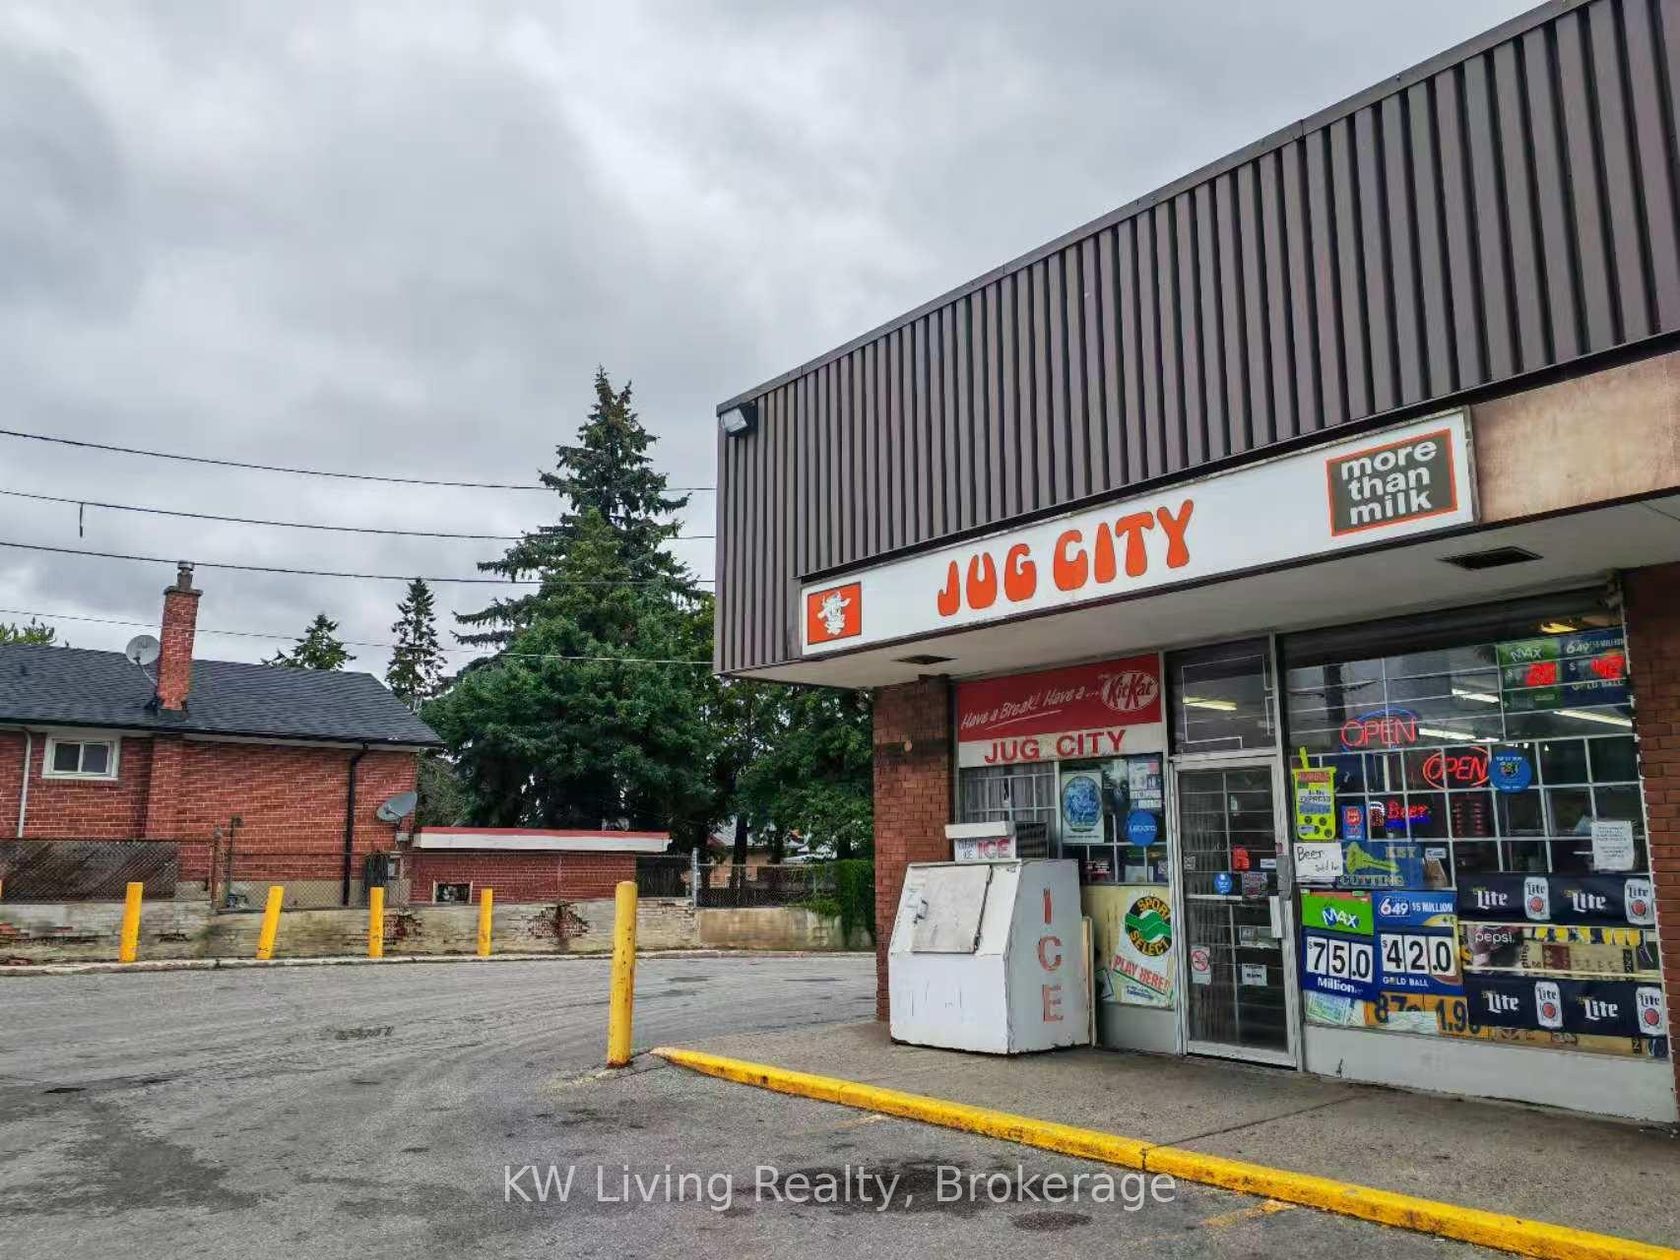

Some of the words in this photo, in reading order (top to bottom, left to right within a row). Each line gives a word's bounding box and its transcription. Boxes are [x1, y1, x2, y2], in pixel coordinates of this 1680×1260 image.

[1341, 441, 1437, 480] more
[1348, 467, 1431, 500] than
[1350, 489, 1432, 524] milk
[937, 543, 1037, 617] JUG
[1053, 499, 1193, 591] CITY
[961, 711, 988, 730] Have
[1043, 688, 1076, 707] Have
[1341, 715, 1417, 748] OPEN
[985, 738, 1040, 764] JUG
[1056, 729, 1126, 757] CITY
[1427, 755, 1488, 781] OPEN
[1387, 799, 1430, 819] Beer
[978, 838, 1010, 859] ICE
[1380, 897, 1409, 916] 649
[1476, 889, 1509, 910] Lite
[1571, 892, 1607, 913] Lite
[1321, 906, 1357, 929] MAX
[1130, 929, 1169, 956] SELECT
[1474, 932, 1513, 945] pepsi
[1038, 887, 1064, 1024] ICE
[1317, 976, 1357, 994] Million
[1485, 991, 1520, 1014] Lite
[1584, 999, 1619, 1021] Lite
